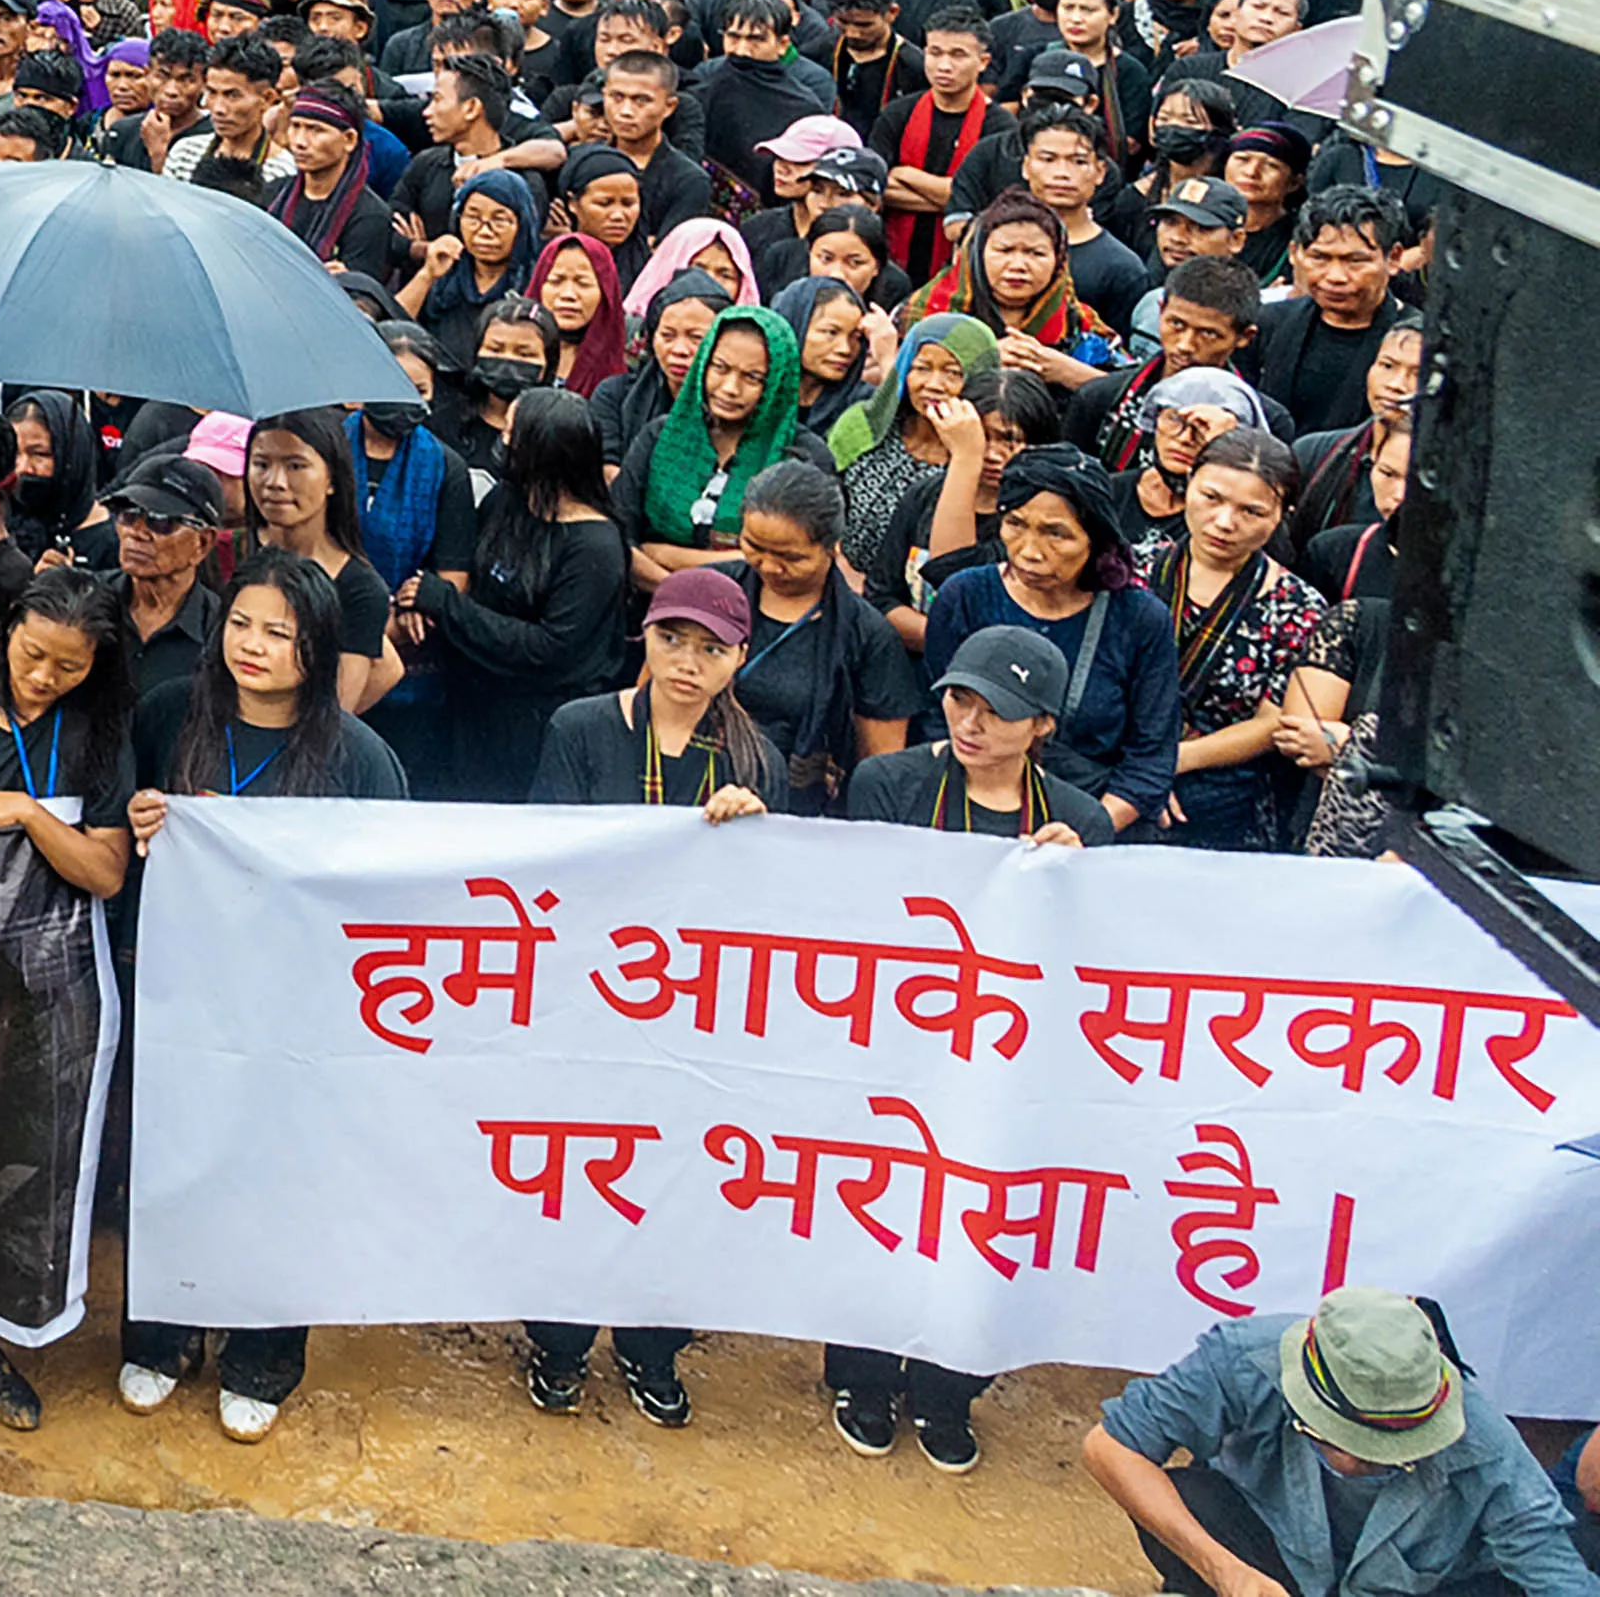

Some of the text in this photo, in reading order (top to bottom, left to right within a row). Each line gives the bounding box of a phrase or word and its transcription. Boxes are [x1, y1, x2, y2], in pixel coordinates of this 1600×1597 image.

[341, 877, 1579, 1113] हमें आपके सरकार
[477, 1120, 662, 1226] पर
[703, 1095, 1131, 1281] भरोसा
